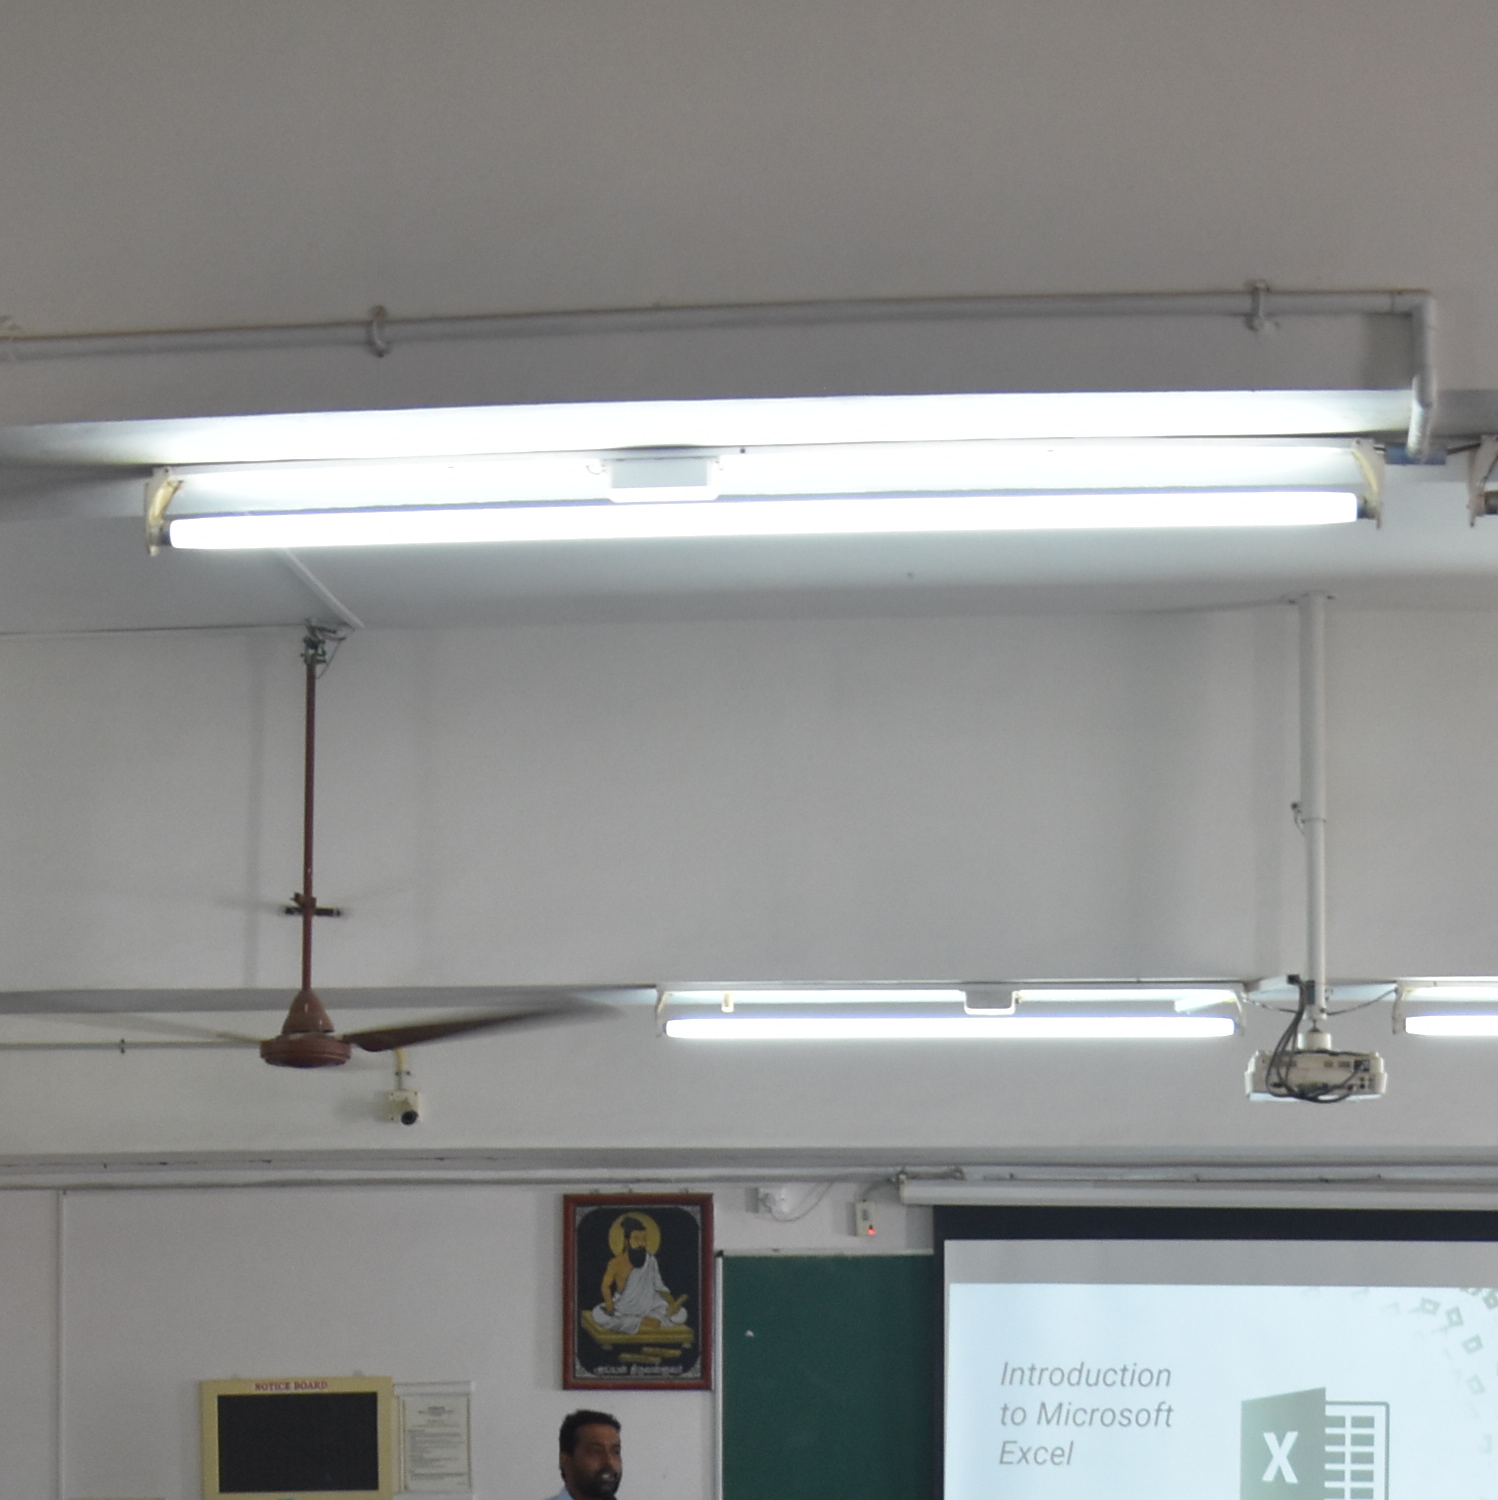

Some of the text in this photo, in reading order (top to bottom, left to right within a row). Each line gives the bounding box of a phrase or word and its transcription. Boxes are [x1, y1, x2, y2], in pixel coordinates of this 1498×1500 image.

[254, 1380, 328, 1392] NOTICE BOARD
[1000, 1360, 1172, 1388] Introduction
[1000, 1401, 1174, 1429] to Microsoft
[999, 1439, 1075, 1467] Excel
